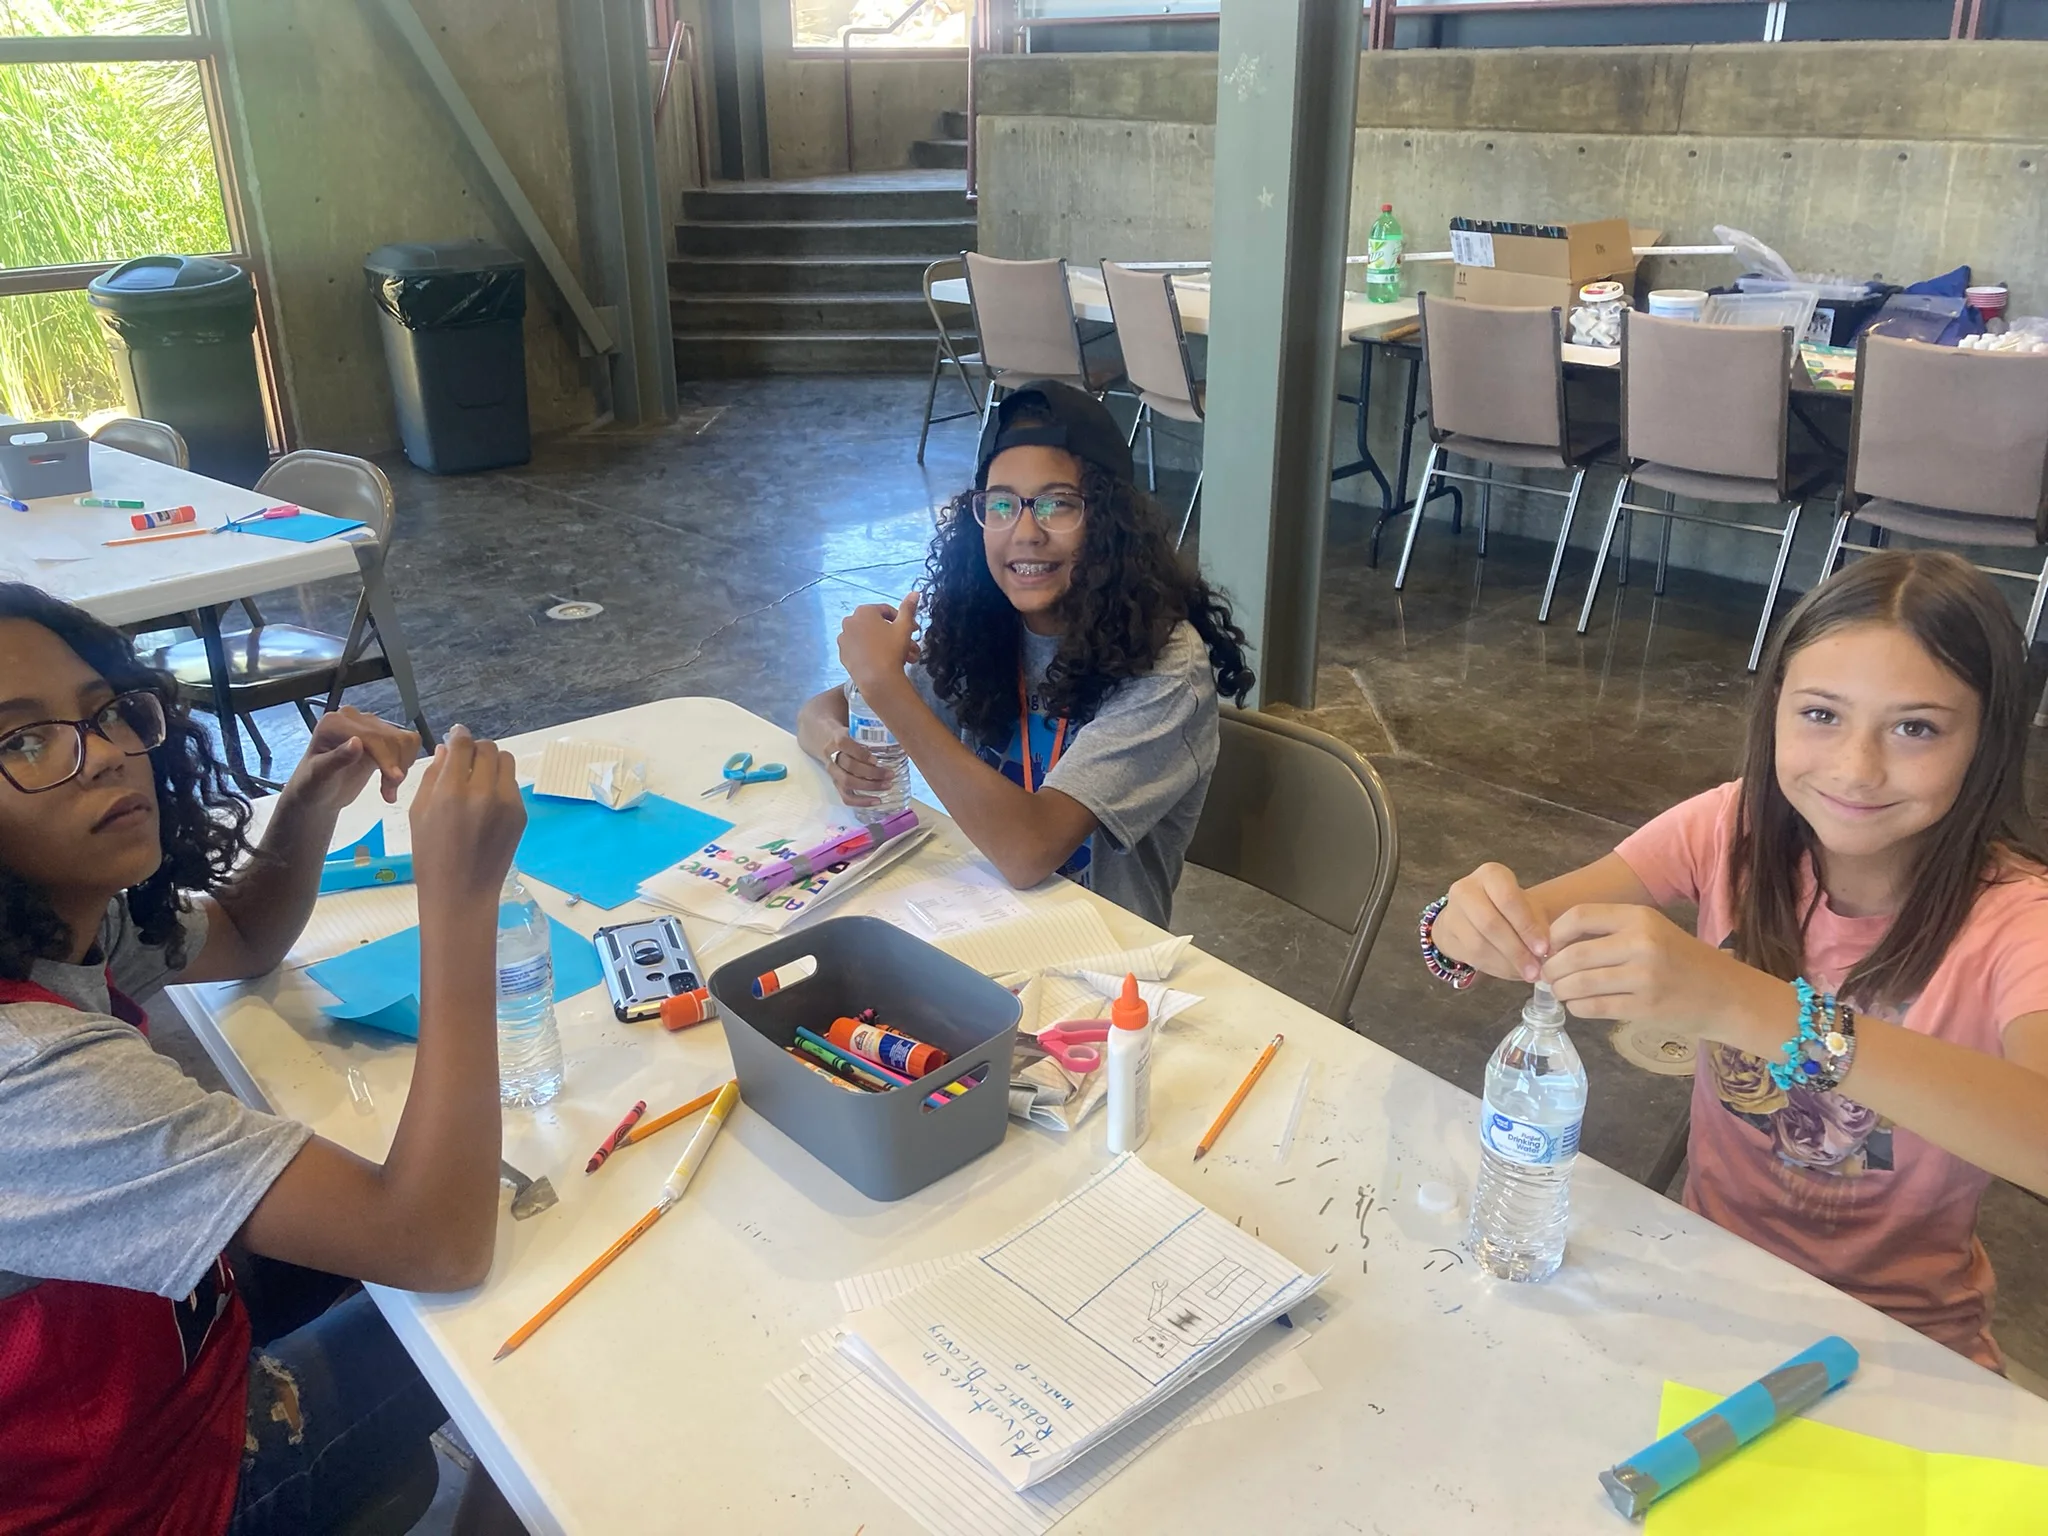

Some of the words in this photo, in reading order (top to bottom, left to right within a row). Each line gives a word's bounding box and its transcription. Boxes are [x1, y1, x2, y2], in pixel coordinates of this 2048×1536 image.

[1507, 1133, 1541, 1149] Drinking
[1516, 1143, 1540, 1154] Water
[922, 1351, 942, 1366] in
[940, 1368, 1040, 1458] Adventures
[994, 1384, 1055, 1440] Robotic
